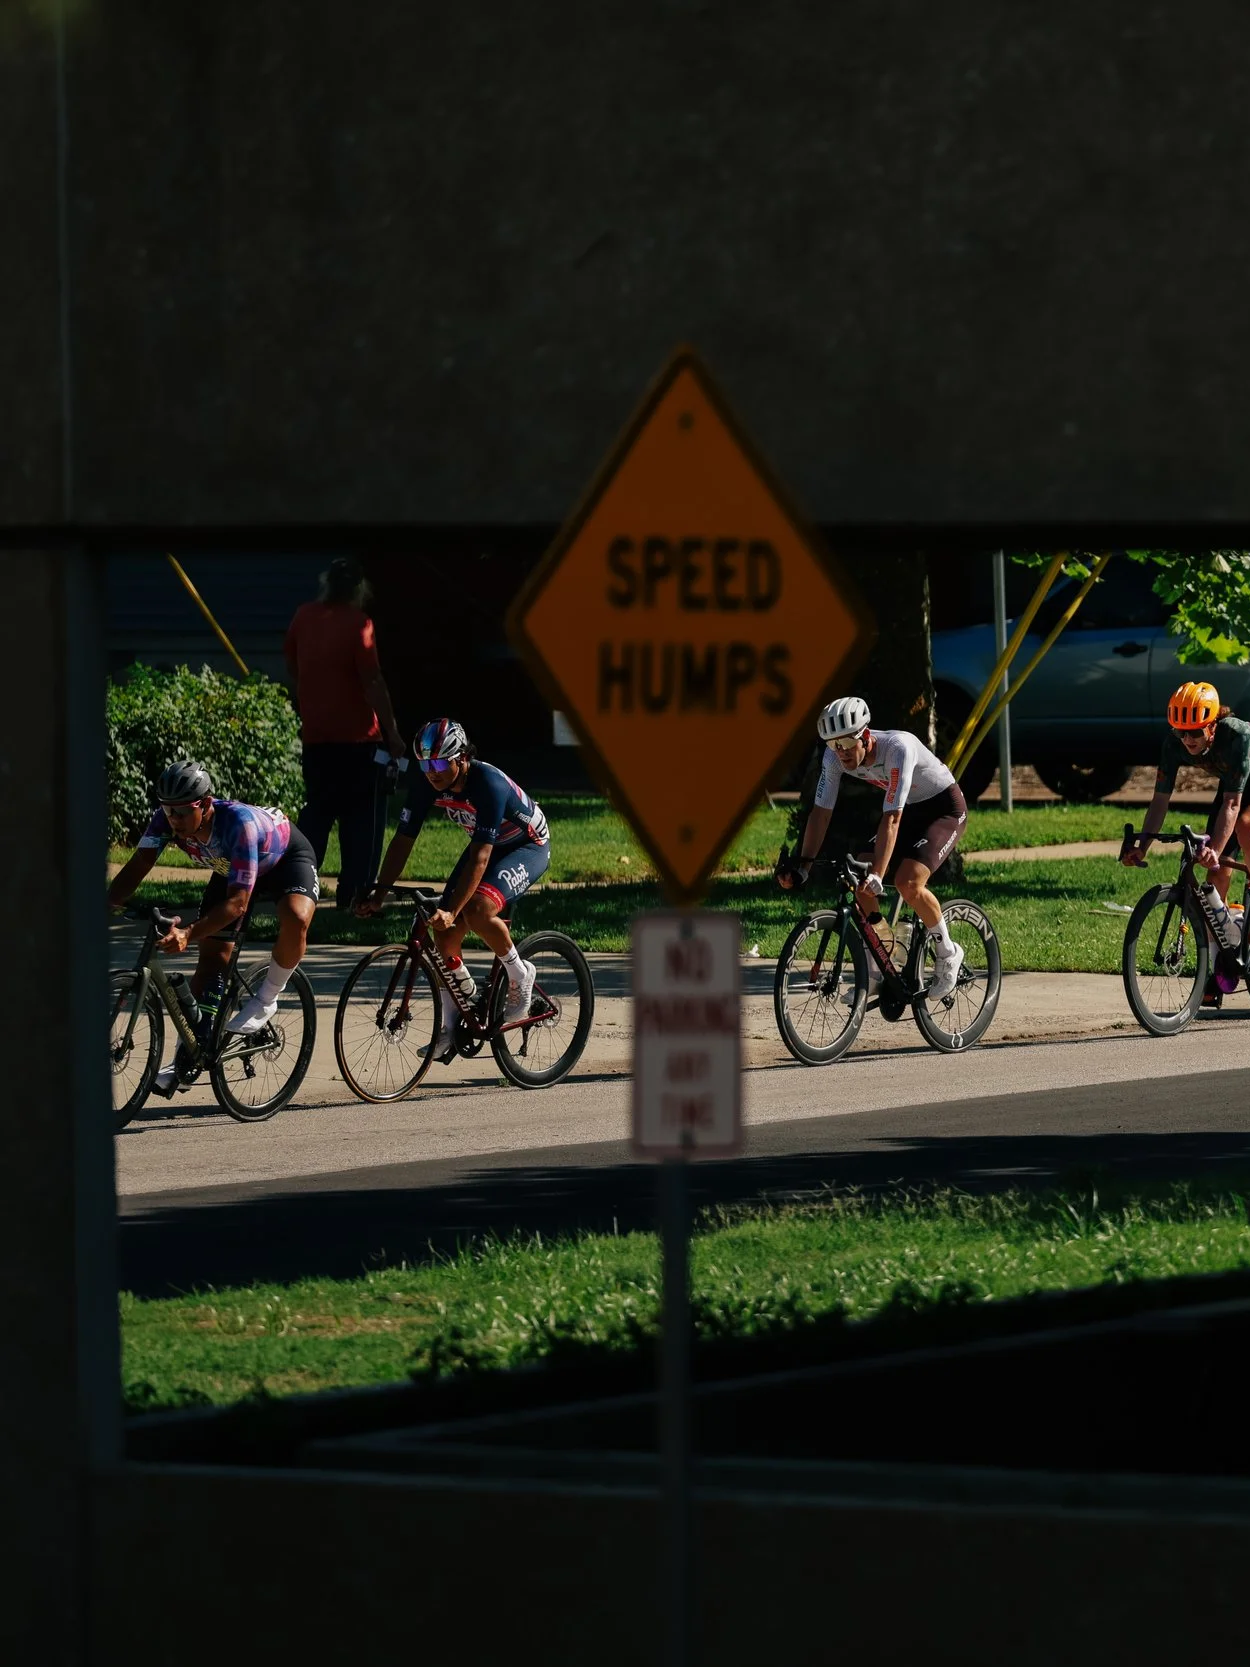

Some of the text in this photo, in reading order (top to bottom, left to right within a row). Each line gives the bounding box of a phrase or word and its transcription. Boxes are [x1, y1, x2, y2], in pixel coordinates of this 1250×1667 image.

[607, 535, 783, 612] SPEED
[597, 641, 795, 715] HUMPS
[498, 863, 529, 890] Pabst
[1193, 884, 1231, 950] SPECIALIZED
[428, 945, 471, 1012] SPECIALIZED
[665, 938, 713, 983] NO
[166, 986, 196, 1044] cannondale
